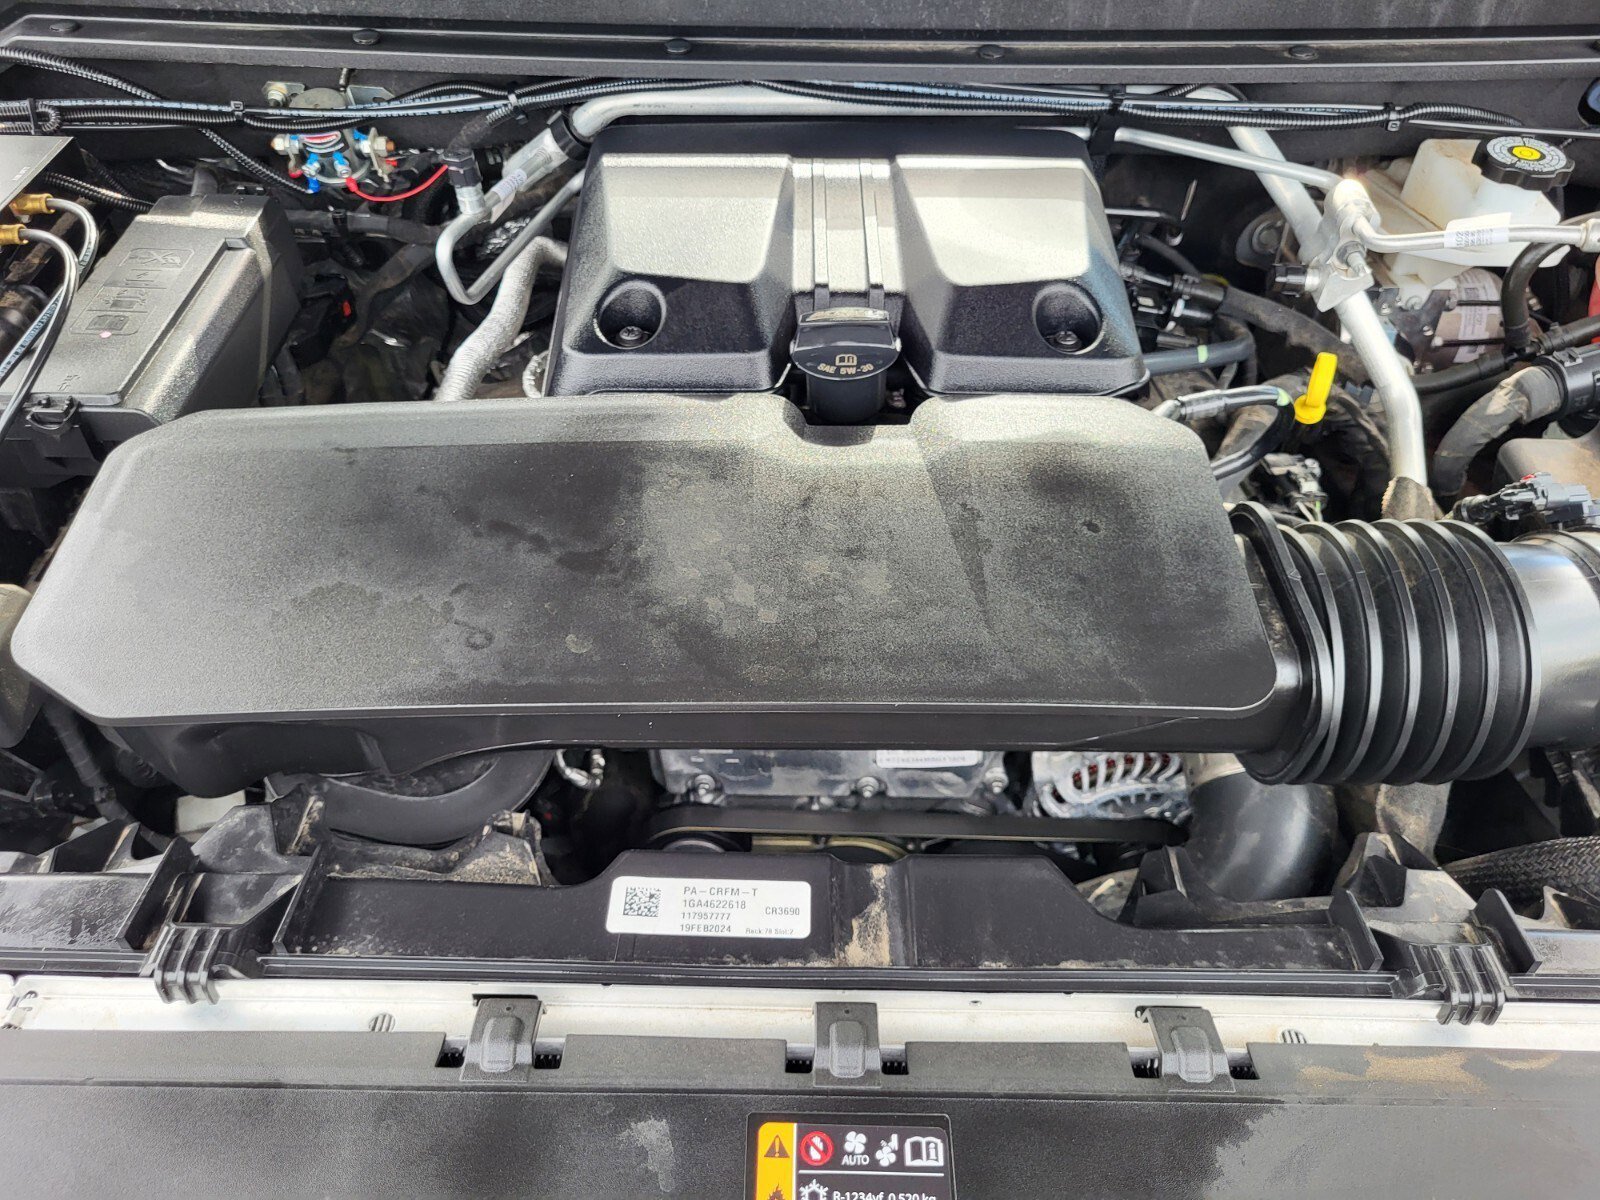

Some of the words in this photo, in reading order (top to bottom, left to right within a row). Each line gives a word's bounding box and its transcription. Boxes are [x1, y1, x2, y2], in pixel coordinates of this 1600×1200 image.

[817, 363, 837, 373] SAE
[840, 363, 874, 375] 5W-30
[682, 899, 746, 909] 1GA4622618
[682, 912, 731, 920] 117957777
[765, 906, 800, 916] CR3690
[680, 924, 732, 933] 19FEB2024
[841, 1154, 870, 1166] AUTO
[887, 1192, 920, 1200] 0520
